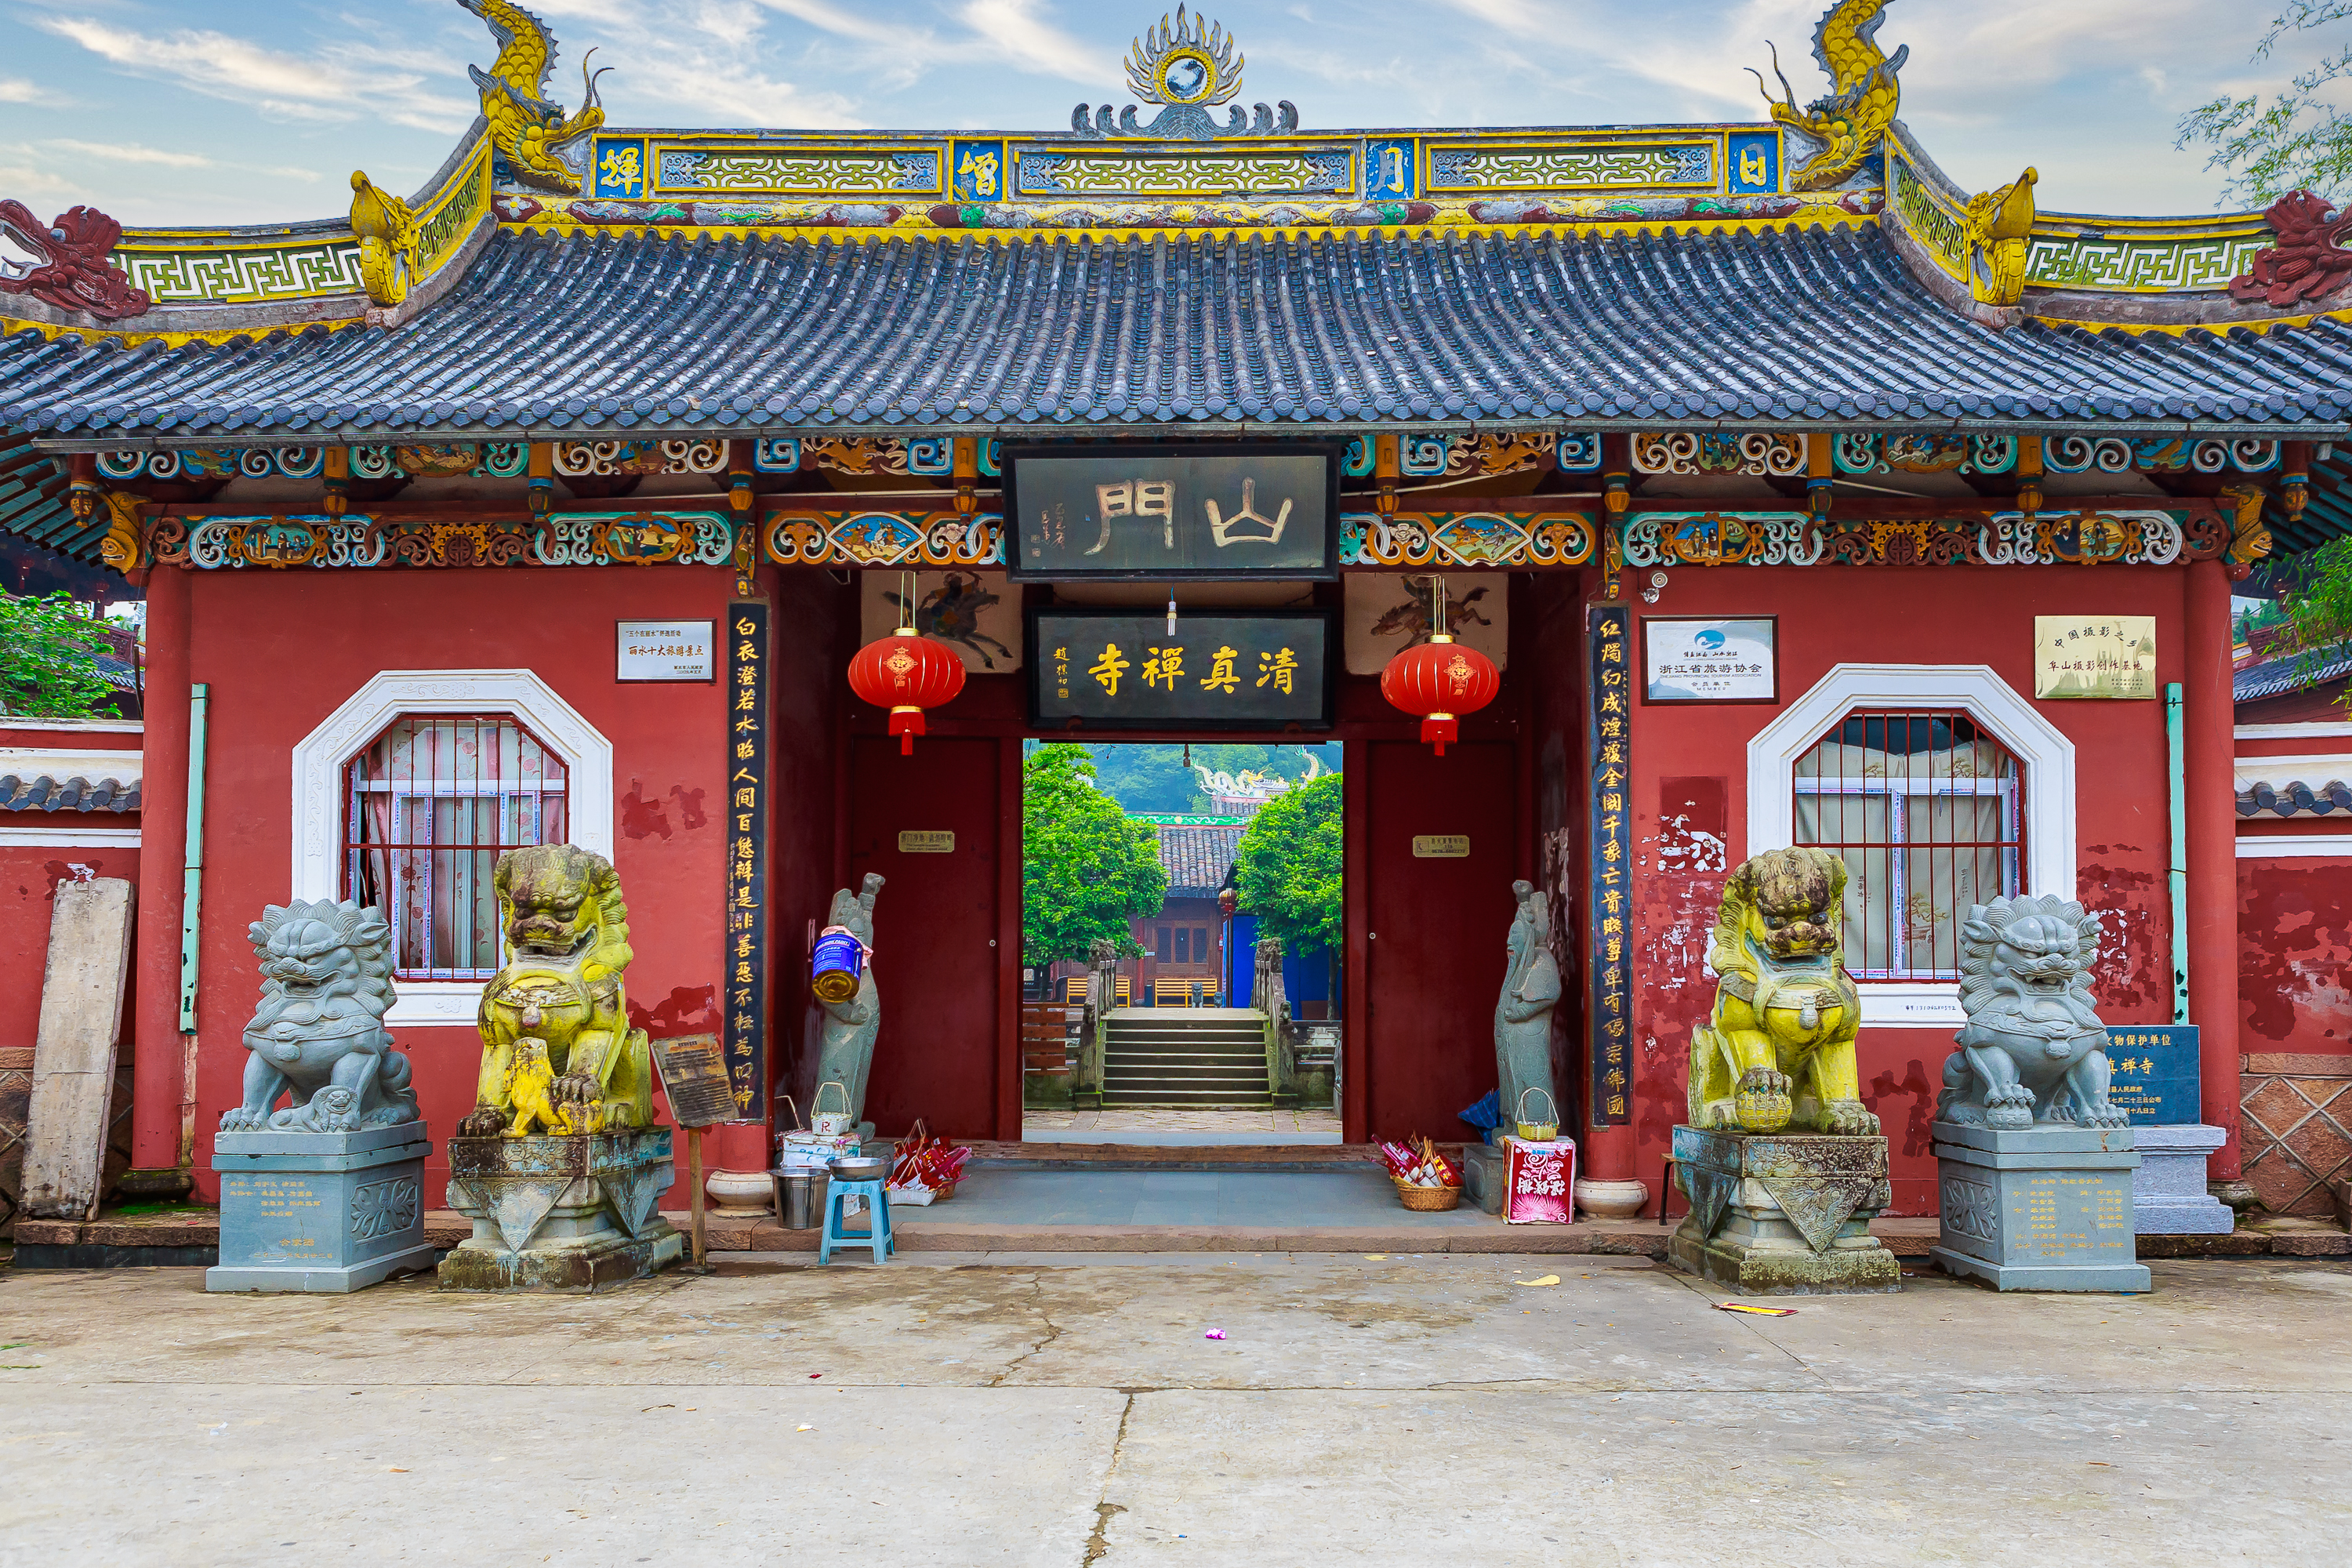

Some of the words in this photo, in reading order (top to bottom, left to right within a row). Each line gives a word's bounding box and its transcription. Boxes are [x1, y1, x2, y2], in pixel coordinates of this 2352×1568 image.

[2054, 626, 2137, 649] 中国摄影之乡
[628, 644, 704, 657] 丽水十大旅游景点
[1659, 663, 1762, 674] 浙江省旅游协会
